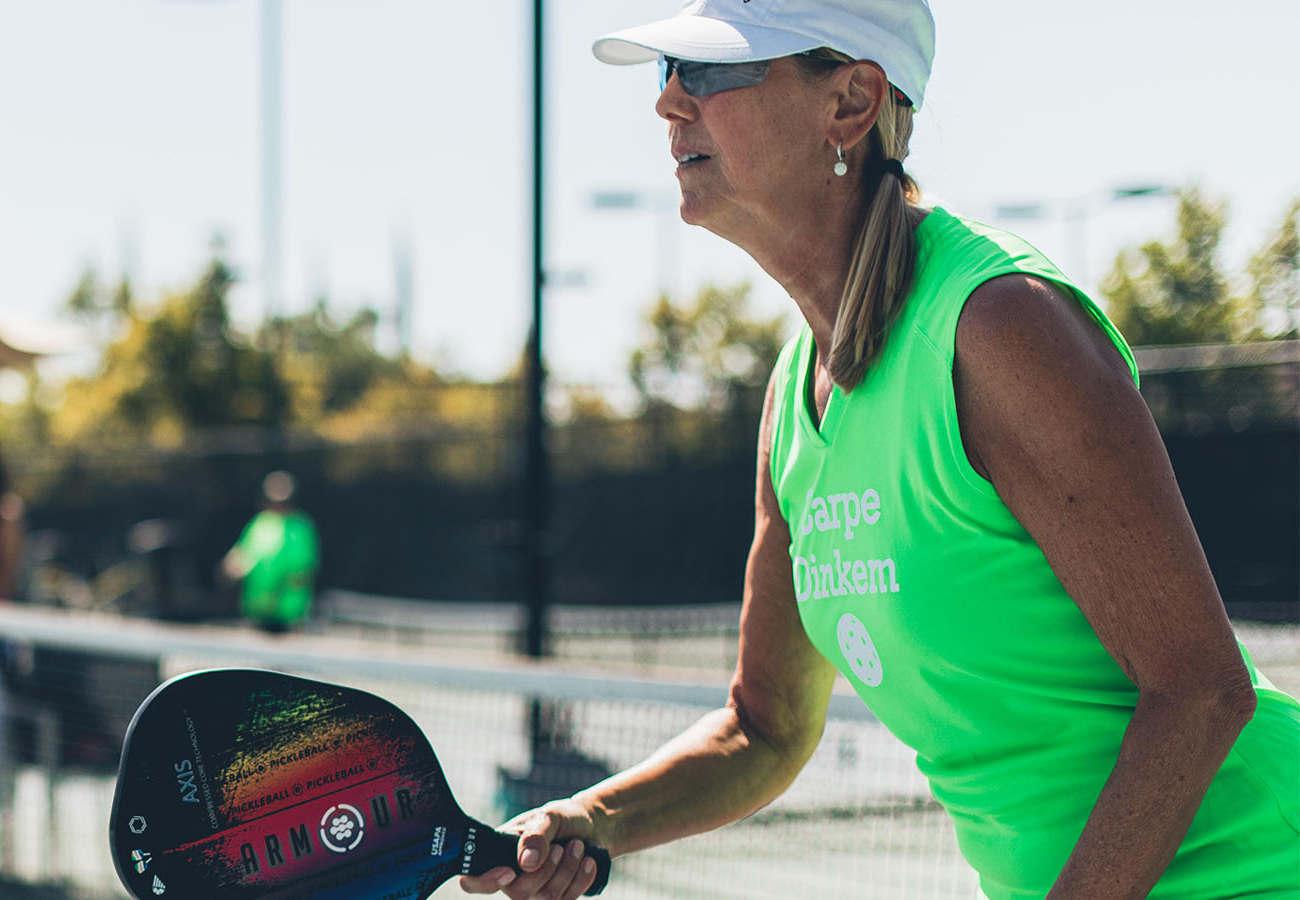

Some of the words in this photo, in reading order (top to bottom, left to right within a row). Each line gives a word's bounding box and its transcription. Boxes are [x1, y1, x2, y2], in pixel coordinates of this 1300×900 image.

[794, 549, 900, 602] Dinkem
[269, 742, 328, 769] PICKLEBALL
[174, 759, 200, 803] AXIS
[231, 789, 291, 815] PICKLEBALL
[306, 765, 365, 791] PICKLEBALL
